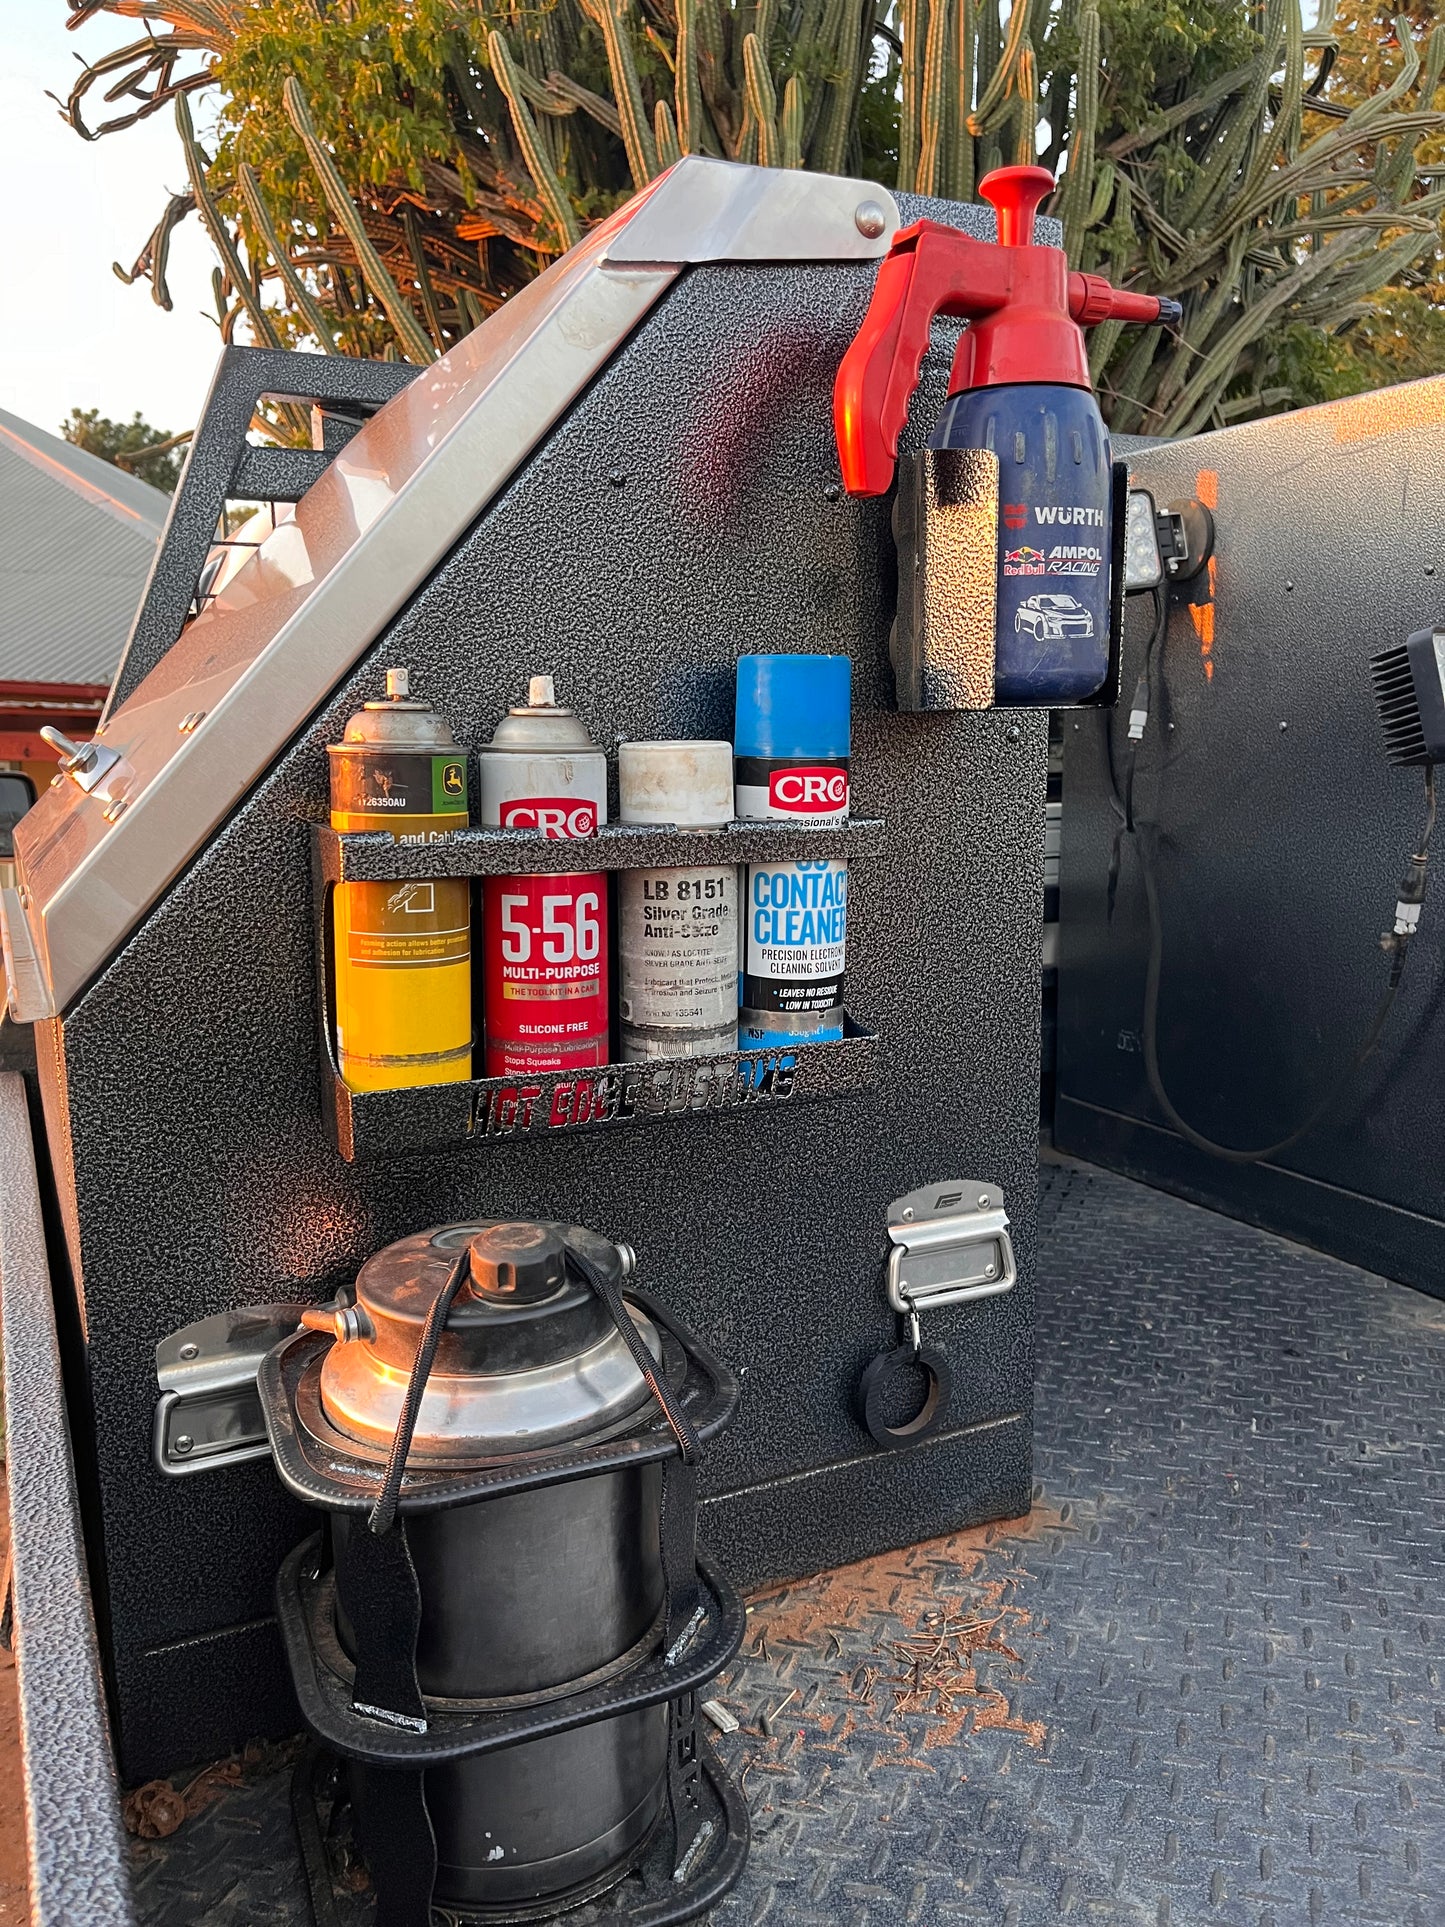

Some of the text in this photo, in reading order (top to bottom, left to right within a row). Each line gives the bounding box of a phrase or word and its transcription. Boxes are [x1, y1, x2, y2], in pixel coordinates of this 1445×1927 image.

[1035, 506, 1103, 527] WÜRTH
[1048, 546, 1103, 560] AMPOL
[1004, 563, 1046, 576] Red Bull
[1046, 561, 1101, 573] RACING
[775, 775, 845, 803] CRC
[505, 807, 593, 839] CRC
[399, 831, 425, 844] and
[429, 831, 456, 844] Cabl
[643, 880, 670, 900] LB
[643, 903, 729, 920] Silver Grade
[501, 892, 600, 963] 5-56
[643, 923, 719, 939] Anti-Seize
[754, 906, 845, 945] CLEANER
[761, 948, 808, 960] PRECISION
[503, 962, 600, 979] MULTI-PURPOSE
[770, 963, 812, 973] CLEANING
[510, 987, 526, 996] THE
[528, 988, 562, 996] TOOLKIT
[565, 987, 573, 995] IN
[581, 985, 595, 993] CAN
[779, 988, 805, 997] LEAVES
[806, 988, 816, 997] NO
[785, 1001, 801, 1010] LOW
[802, 1001, 810, 1009] IN
[519, 1021, 589, 1034] SILICONE FREE
[504, 1055, 562, 1066] Stops Squeaks
